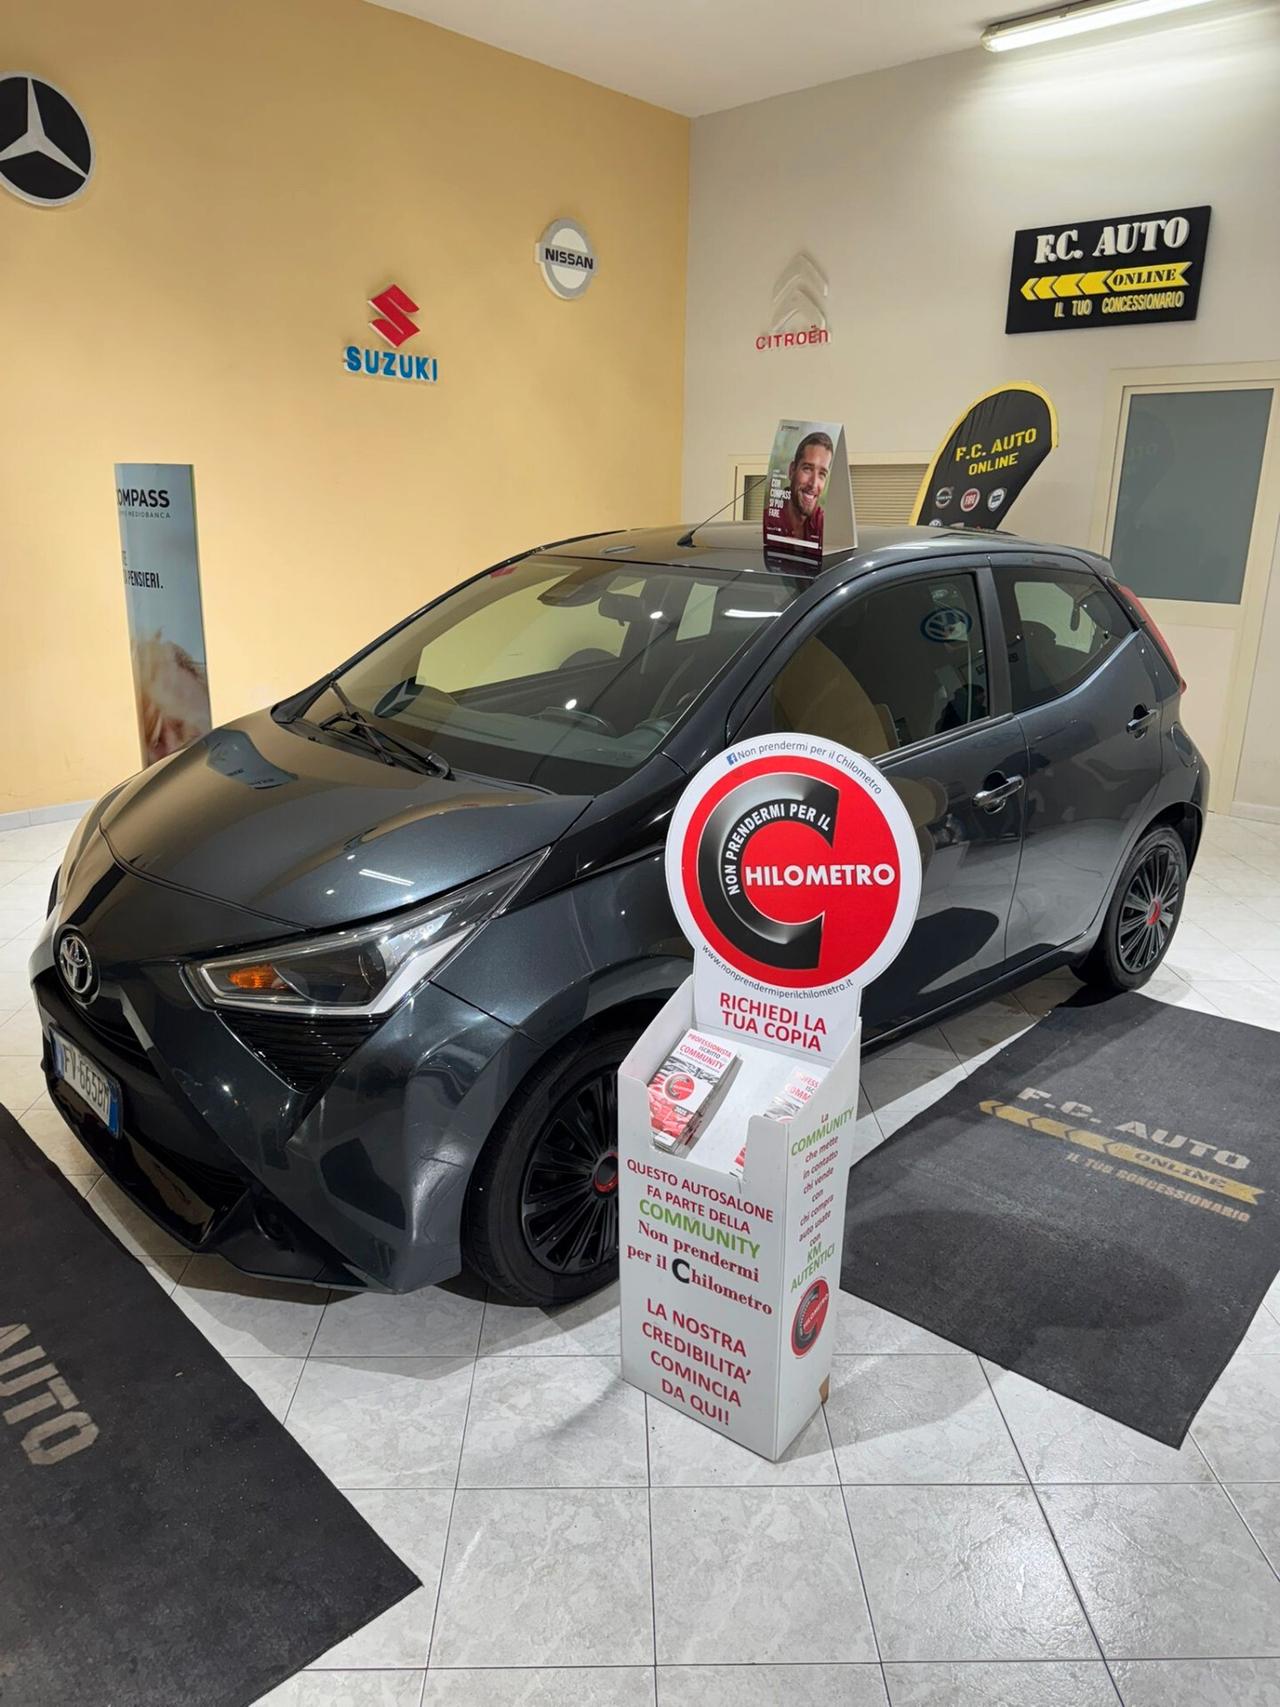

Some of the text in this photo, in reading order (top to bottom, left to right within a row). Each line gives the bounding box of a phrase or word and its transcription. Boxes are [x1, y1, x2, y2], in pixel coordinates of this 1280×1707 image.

[545, 248, 593, 269] NISSAN
[1033, 217, 1190, 264] F.C. AUTO
[1112, 269, 1177, 286] ONLINE
[1054, 291, 1184, 318] IL TUO CONCESSIONARIO
[345, 346, 438, 382] SUZUKI
[955, 428, 1037, 461] F.C. AUTO
[969, 453, 1018, 476] ONLINE
[737, 740, 882, 795] Non prendermi per il Chilometro
[724, 803, 831, 895] NON PRENDERMI PER IL
[745, 863, 895, 887] HILOMETRO
[702, 944, 853, 999] www.nonprendermiperilchilometro.it
[719, 993, 826, 1035] RICHIEDI LA
[722, 1010, 821, 1052] TUA COPIA
[679, 1044, 725, 1069] COMMUNITY
[687, 1033, 732, 1058] PROFESSIONISTA
[791, 1106, 854, 1156] COMMUNITY
[821, 1113, 829, 1123] La
[803, 1150, 838, 1180] in contatto
[805, 1136, 839, 1163] che mette
[1114, 1121, 1250, 1170] AUTO
[803, 1167, 834, 1194] chi vende
[1134, 1152, 1228, 1188] ONLINE
[627, 1159, 774, 1223] QUESTO AUTOSALONE
[647, 1185, 750, 1234] FA PARTE DELLA
[811, 1189, 823, 1202] con
[1084, 1158, 1114, 1174] TUO
[1116, 1169, 1250, 1222] CONCESSIONARIO
[639, 1199, 760, 1259] COMMUNITY
[800, 1194, 834, 1226] chi compra
[638, 1219, 759, 1283] Non prendermi
[799, 1225, 814, 1242] auto
[807, 1242, 821, 1262] KM
[810, 1233, 821, 1247] con
[627, 1245, 772, 1315] per il Chilometro
[791, 1243, 835, 1293] AUTENTICI
[647, 1298, 747, 1358] LA NOSTRA
[642, 1322, 751, 1384] CREDIBILITA'
[650, 1350, 742, 1408] COMINCIA
[661, 1378, 730, 1426] DA QUI!
